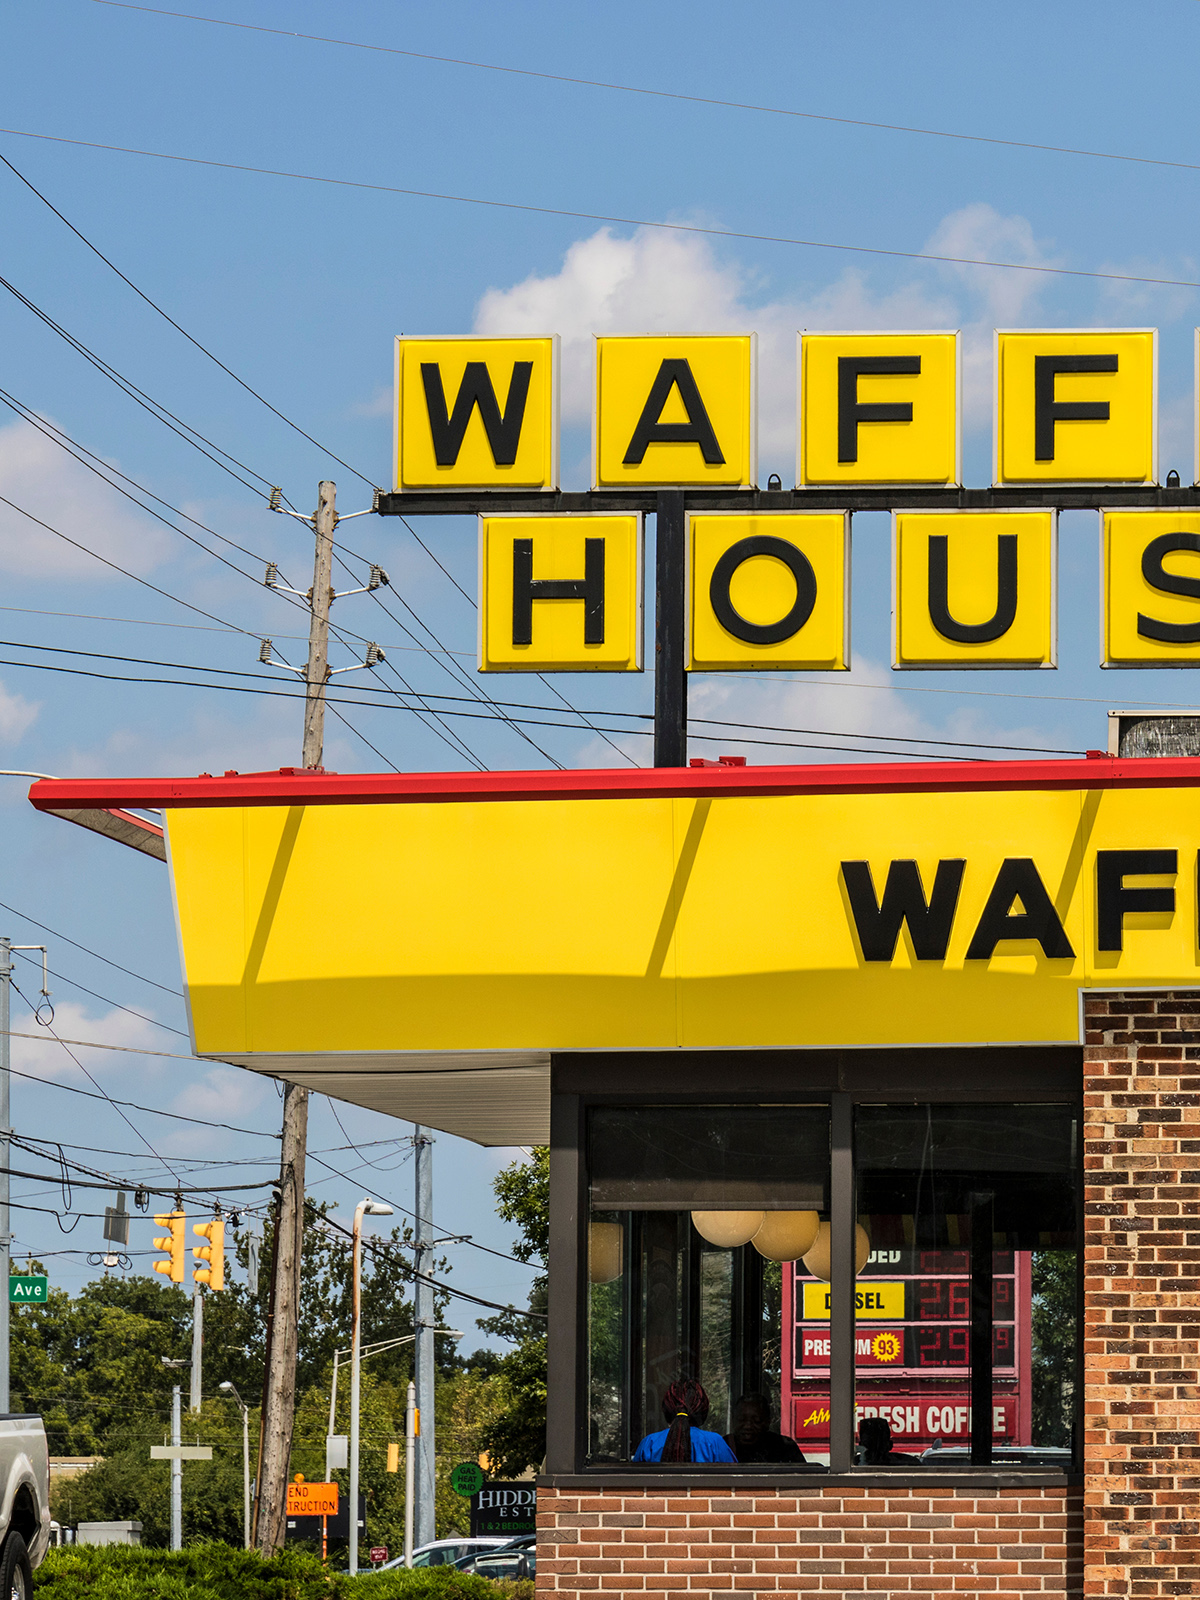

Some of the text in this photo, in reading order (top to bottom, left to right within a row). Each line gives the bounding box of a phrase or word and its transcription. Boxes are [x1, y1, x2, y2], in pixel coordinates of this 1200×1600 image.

[13, 1282, 42, 1296] Ave
[824, 1292, 885, 1309] DSEL
[804, 1339, 894, 1356] PREM 93
[926, 1406, 1005, 1433] COFE
[460, 1467, 476, 1475] GAS
[289, 1487, 309, 1497] END
[457, 1483, 476, 1491] PAID
[287, 1500, 336, 1512] TRUCTION
[499, 1506, 535, 1517] EST
[501, 1522, 536, 1530] BEDROO
